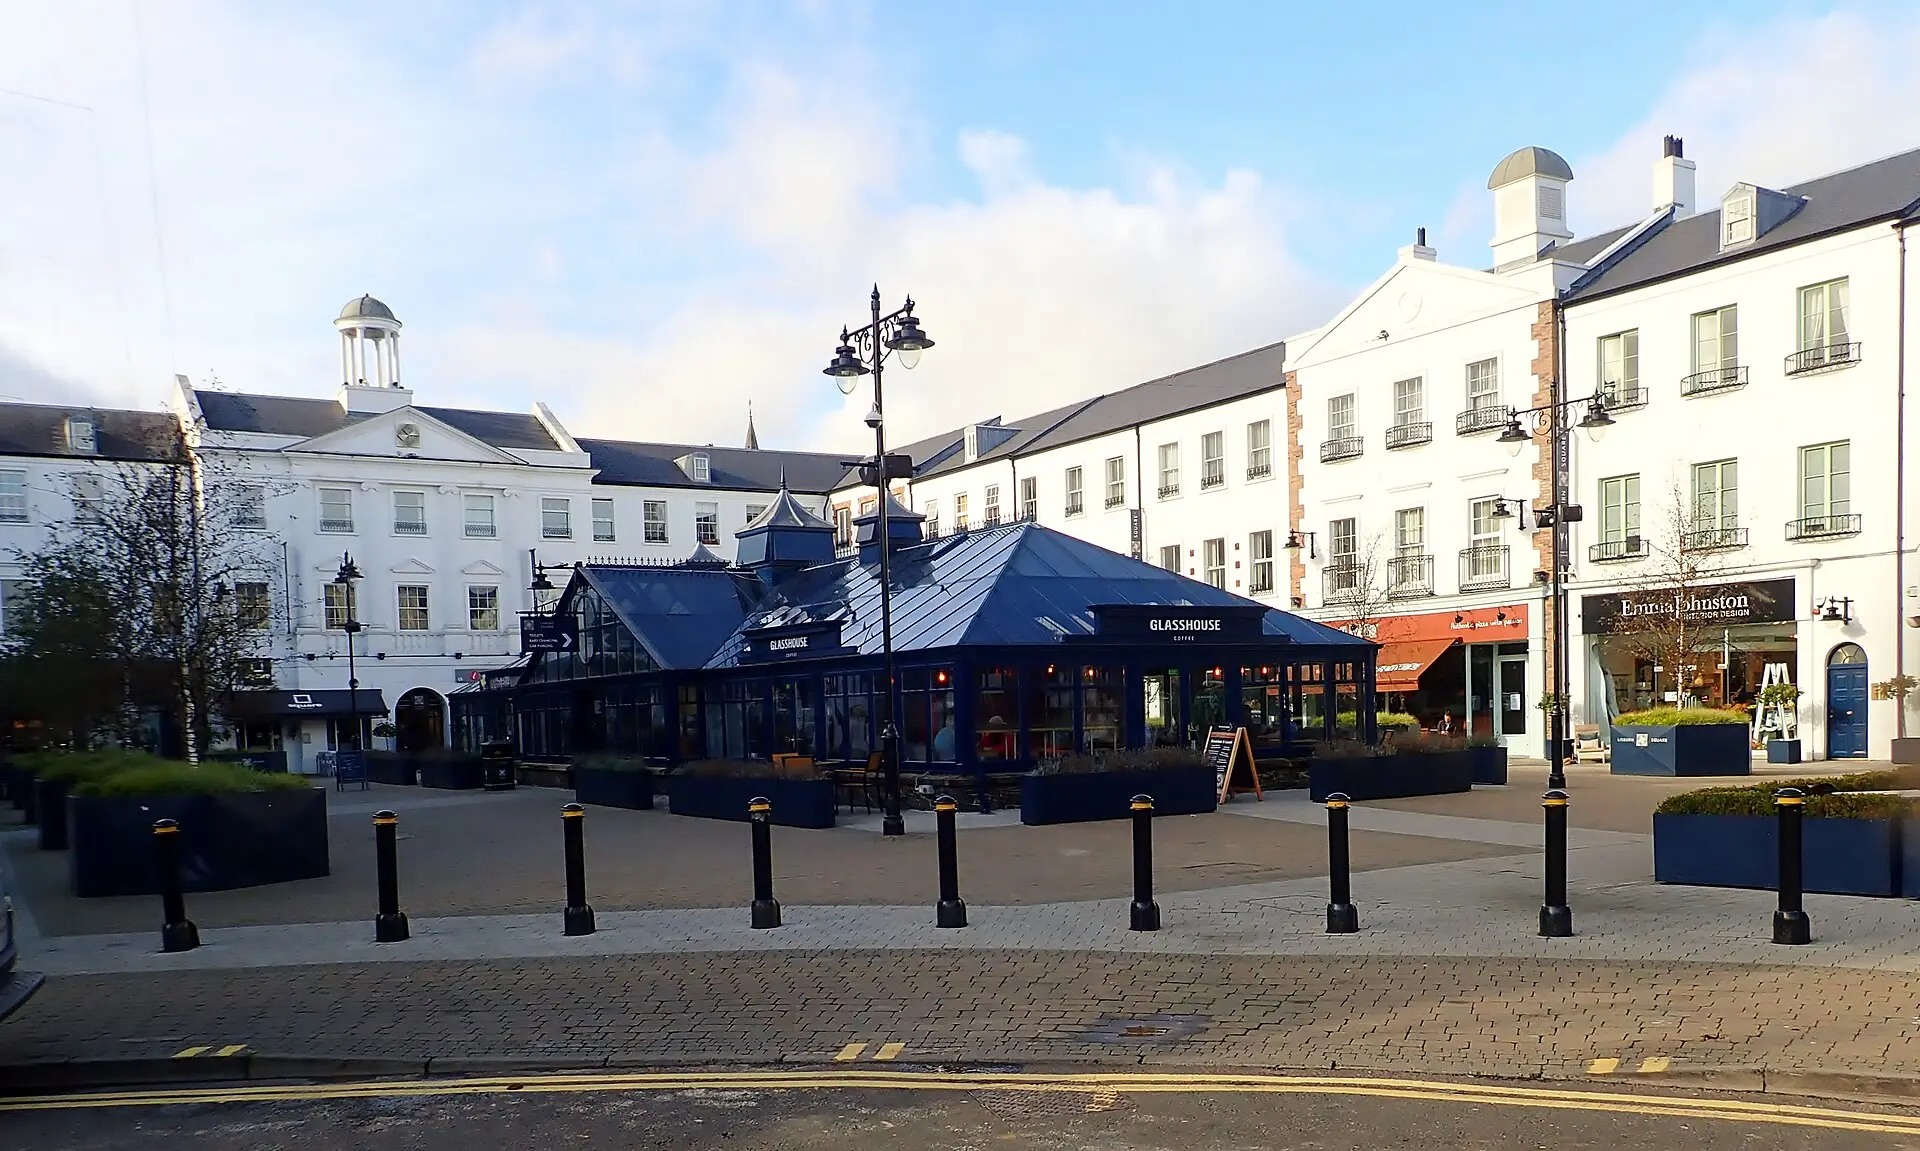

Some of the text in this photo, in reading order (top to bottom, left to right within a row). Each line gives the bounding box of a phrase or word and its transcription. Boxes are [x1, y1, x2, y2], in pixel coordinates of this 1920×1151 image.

[1621, 593, 1749, 619] Emma Johnston
[1720, 608, 1750, 618] DESIGN
[1149, 619, 1221, 631] GLASSHOUSE
[1475, 620, 1489, 630] pizza
[770, 636, 808, 650] GLASSHOUSE
